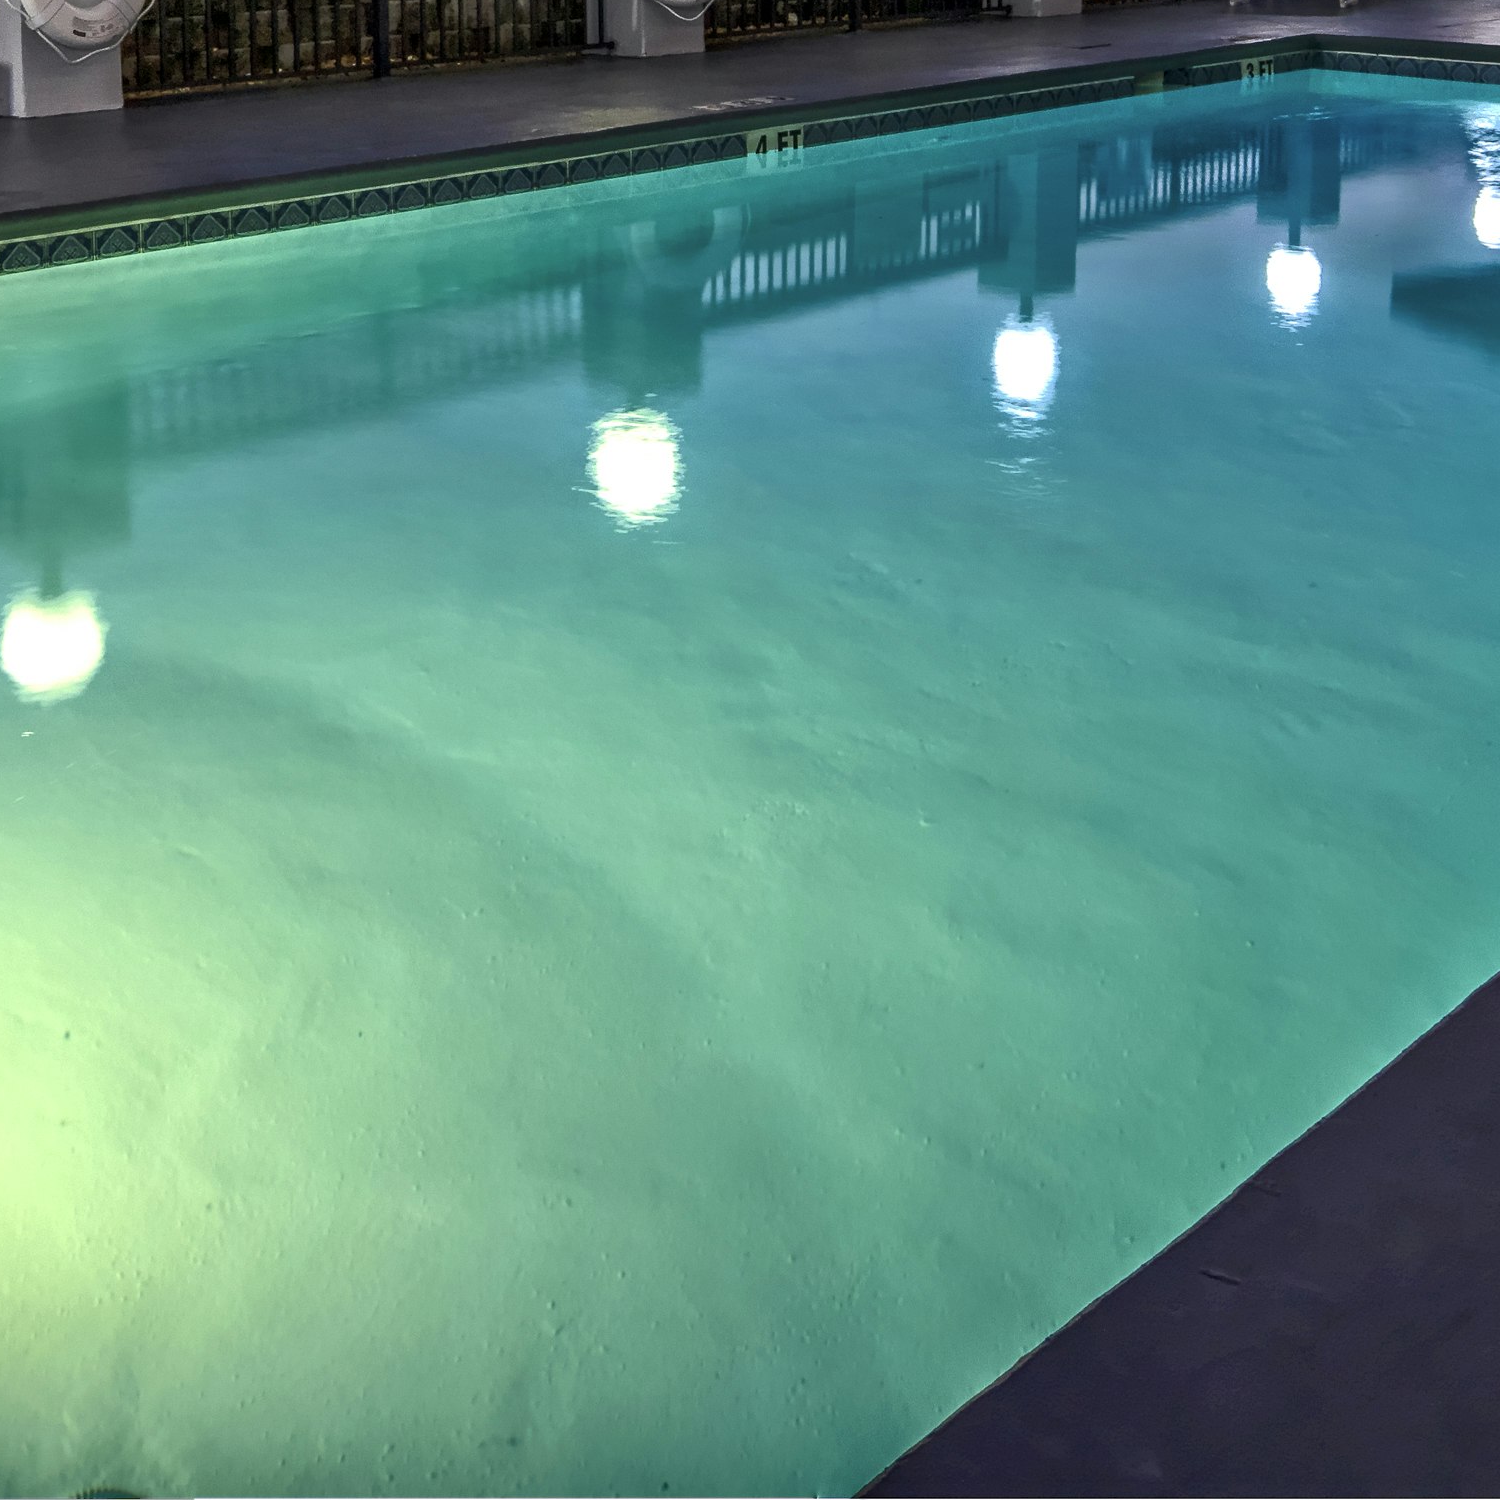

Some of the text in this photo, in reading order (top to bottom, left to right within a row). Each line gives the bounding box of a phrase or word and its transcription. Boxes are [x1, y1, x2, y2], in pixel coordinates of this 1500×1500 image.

[1246, 59, 1273, 78] 3 FT
[755, 129, 802, 154] 4 FT
